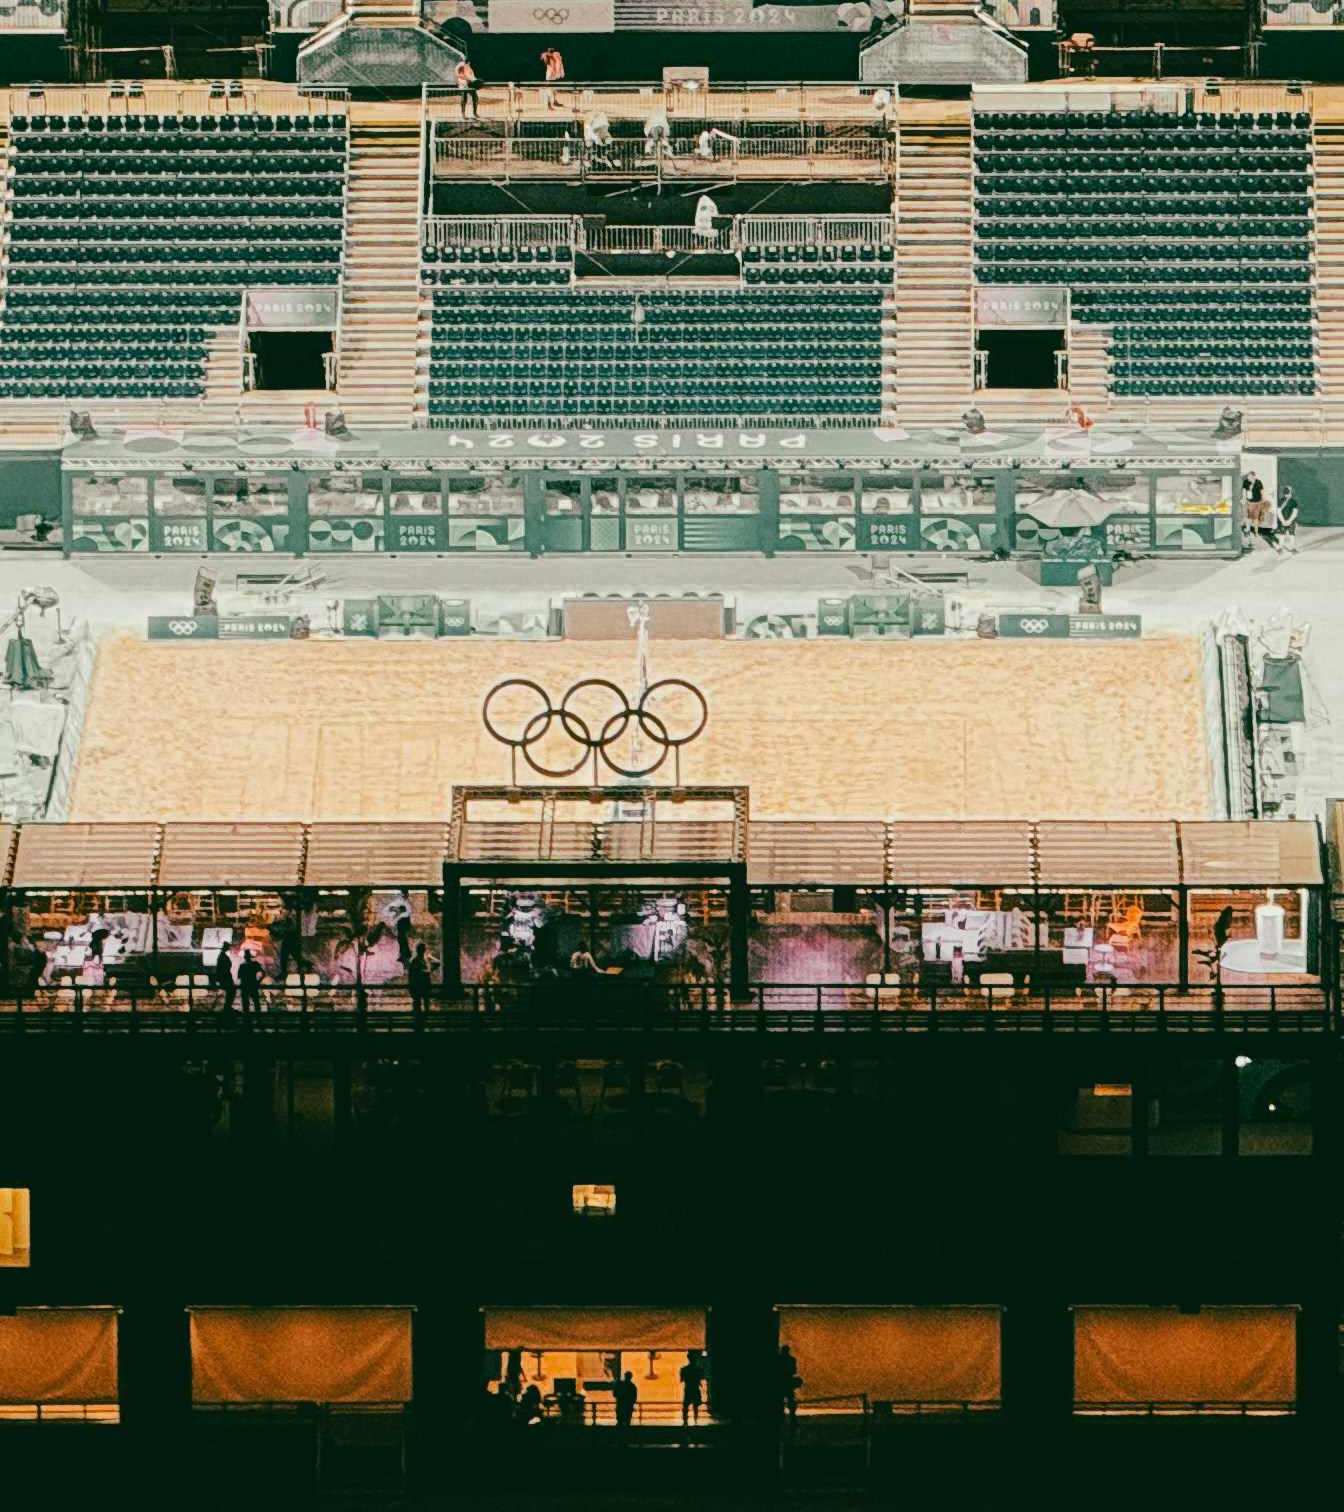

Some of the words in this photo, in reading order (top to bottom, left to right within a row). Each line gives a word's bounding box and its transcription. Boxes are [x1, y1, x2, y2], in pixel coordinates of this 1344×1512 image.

[657, 7, 725, 25] PARIS
[734, 7, 796, 25] 2024
[448, 434, 605, 449] 2024
[633, 433, 806, 449] PARIS
[164, 525, 200, 536] PARIS
[399, 525, 436, 536] PARIS
[870, 524, 907, 535] PARIS
[164, 535, 200, 547] 2024
[399, 535, 436, 546] 2024
[870, 534, 907, 546] 2024
